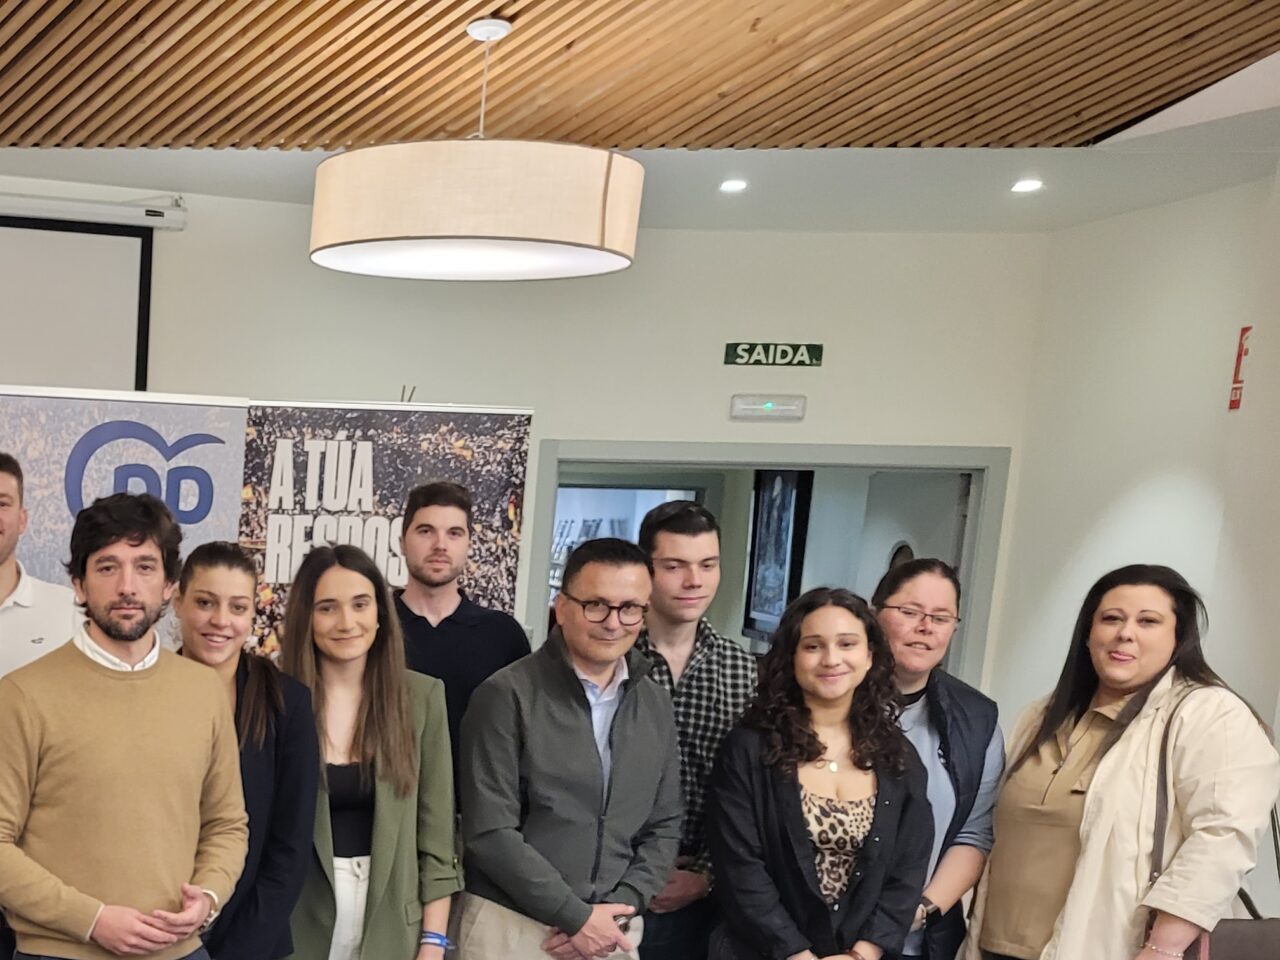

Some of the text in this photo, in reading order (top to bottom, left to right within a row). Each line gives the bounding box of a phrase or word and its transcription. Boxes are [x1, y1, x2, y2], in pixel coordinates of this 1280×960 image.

[735, 344, 811, 365] SAIDA
[269, 430, 374, 512] A TÚA
